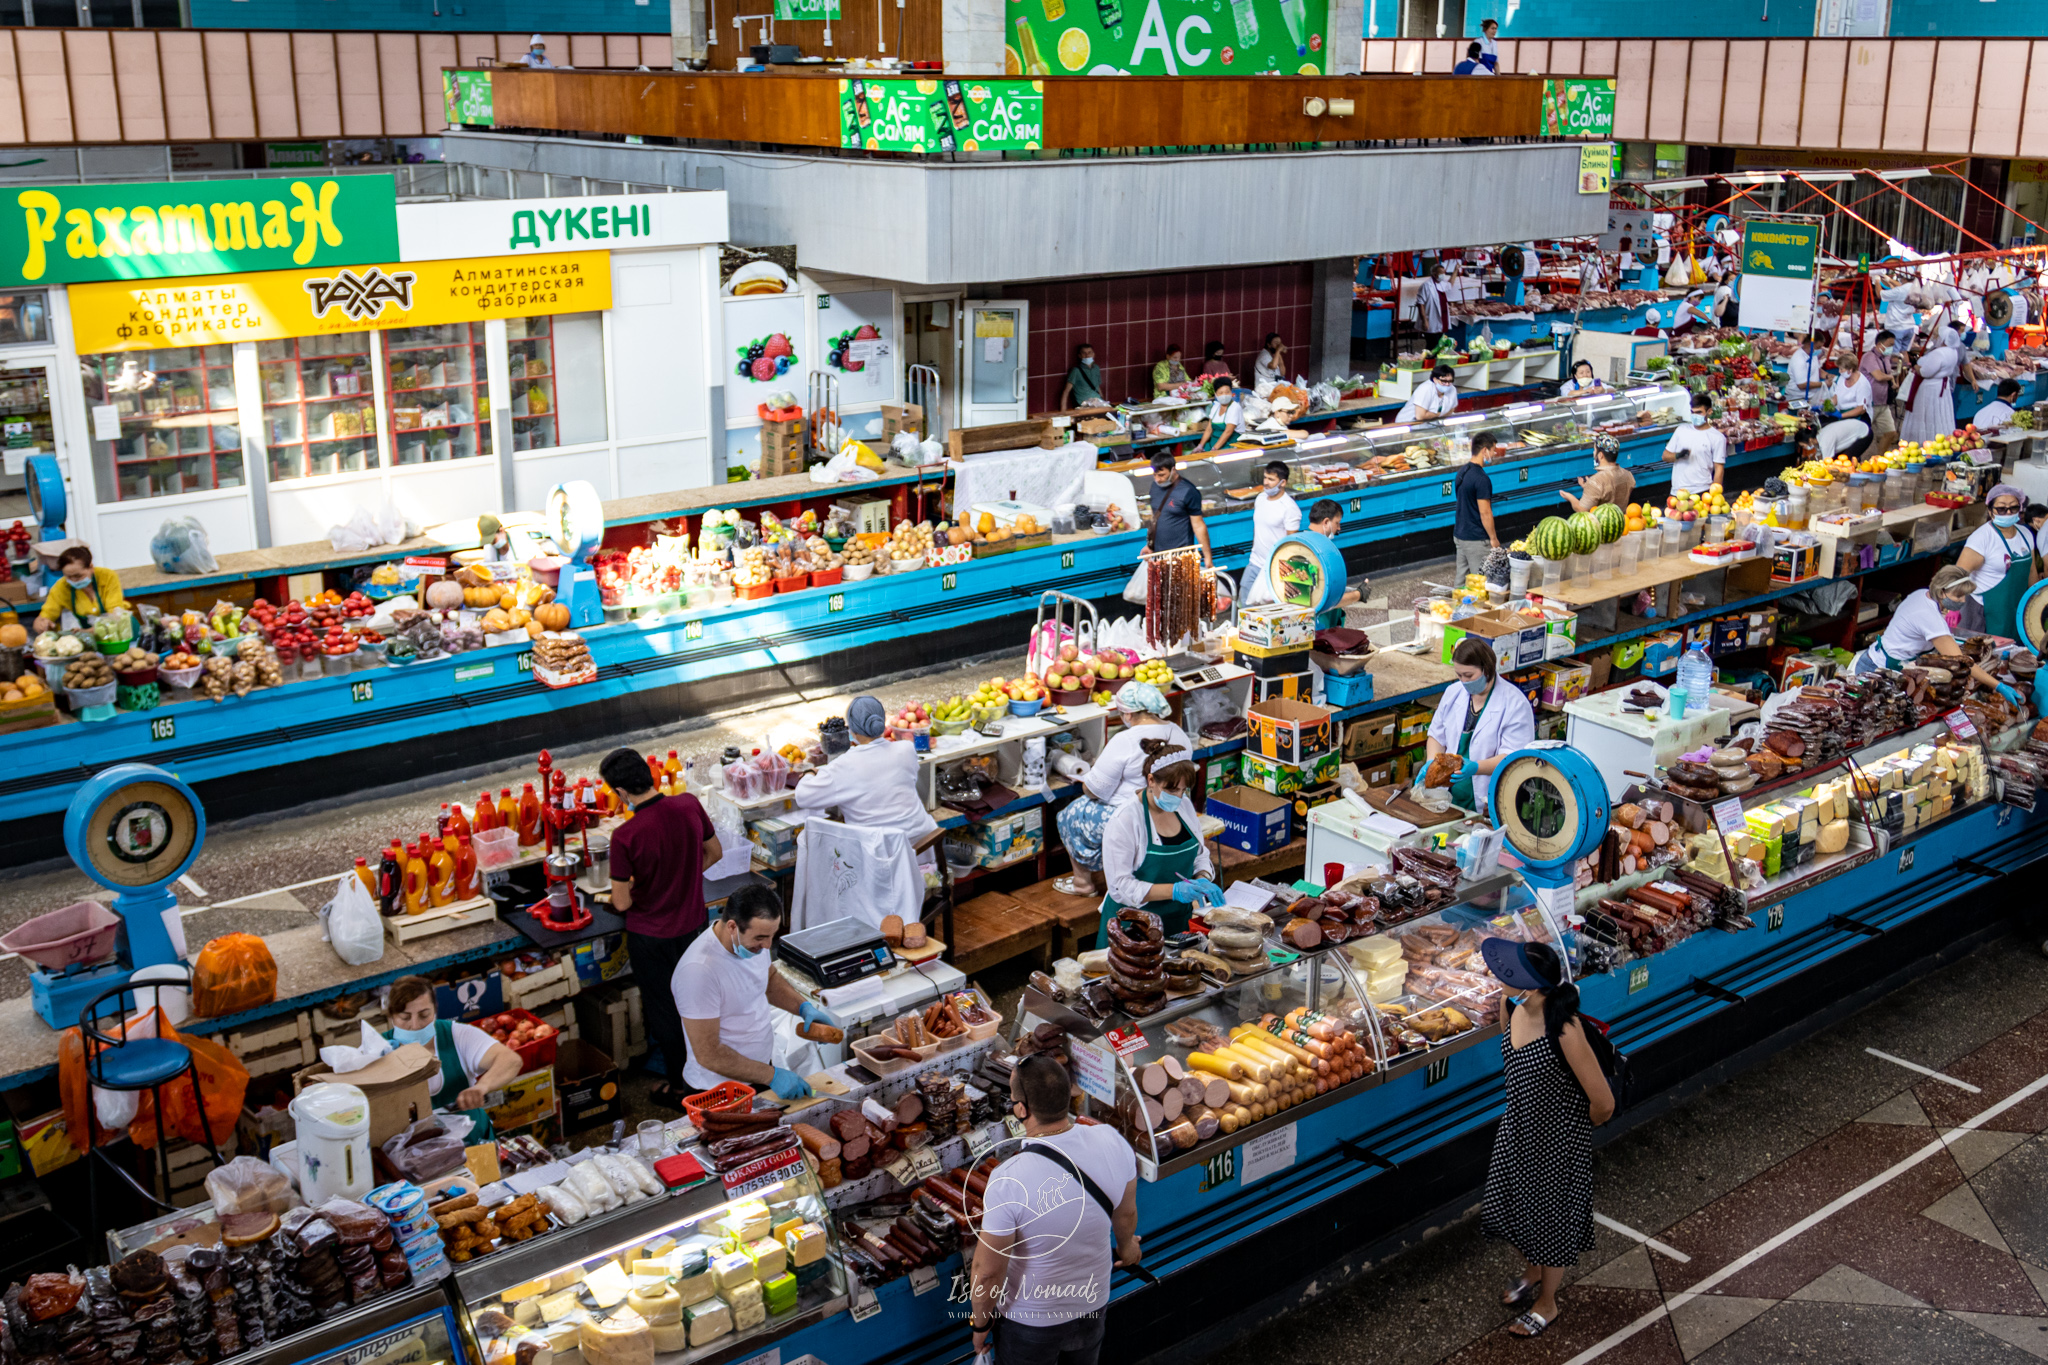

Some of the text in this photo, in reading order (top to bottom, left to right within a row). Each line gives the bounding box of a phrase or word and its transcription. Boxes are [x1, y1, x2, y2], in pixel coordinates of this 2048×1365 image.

[463, 101, 493, 118] Салям
[885, 96, 910, 121] Ас
[990, 96, 1022, 121] Ас
[1582, 92, 1602, 112] Ас
[1570, 109, 1611, 127] Салям
[873, 118, 925, 143] Салям
[973, 119, 1040, 142] Салям
[1582, 160, 1608, 169] Блины
[510, 204, 650, 250] ДҮКЕНІ
[1860, 256, 1867, 265] 4
[453, 263, 580, 282] Алматинская
[138, 287, 237, 306] Алматы
[450, 276, 584, 297] кондитерская
[477, 293, 558, 310] фабрика
[129, 302, 248, 323] кондитер
[116, 314, 262, 340] фабрикасы
[1442, 482, 1452, 494] 175
[1350, 500, 1361, 512] 174
[1062, 552, 1074, 567] 171
[943, 574, 955, 589] 170
[829, 594, 843, 611] 169
[152, 717, 174, 739] 165
[1428, 1057, 1447, 1083] 117
[737, 1160, 768, 1178] KASPI
[768, 1148, 797, 1165] GOLD
[1208, 1149, 1232, 1184] 116
